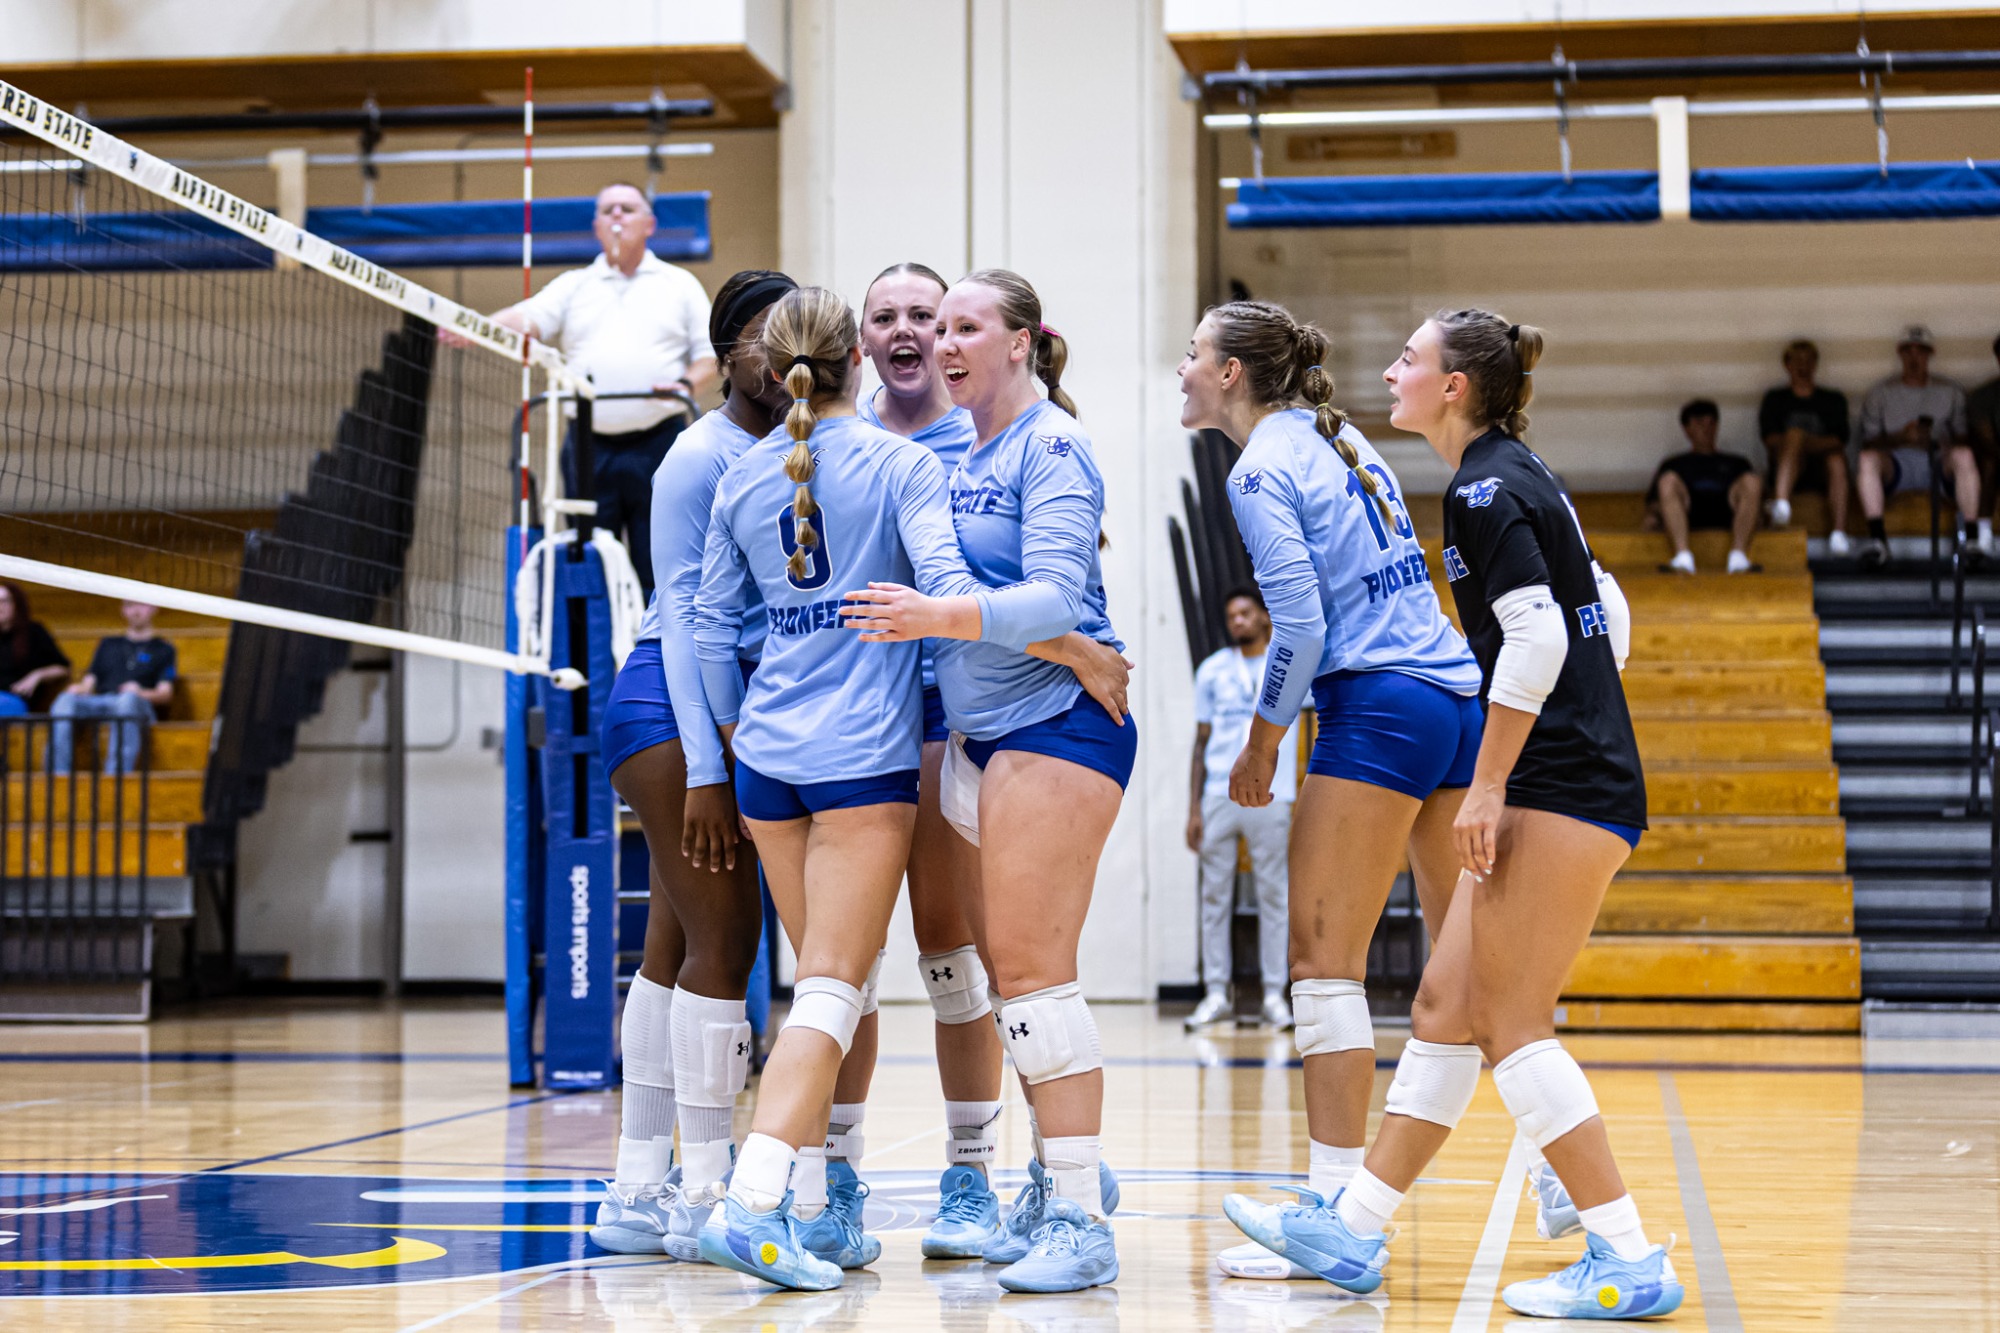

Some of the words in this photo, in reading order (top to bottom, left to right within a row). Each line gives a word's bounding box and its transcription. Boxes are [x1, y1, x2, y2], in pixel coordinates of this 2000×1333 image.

[0, 83, 37, 124] RED
[43, 107, 93, 150] STATE
[1345, 463, 1414, 553] 13
[1263, 664, 1288, 709] STRONG
[1274, 646, 1294, 666] OX
[568, 865, 591, 925] sports
[568, 925, 591, 999] imports
